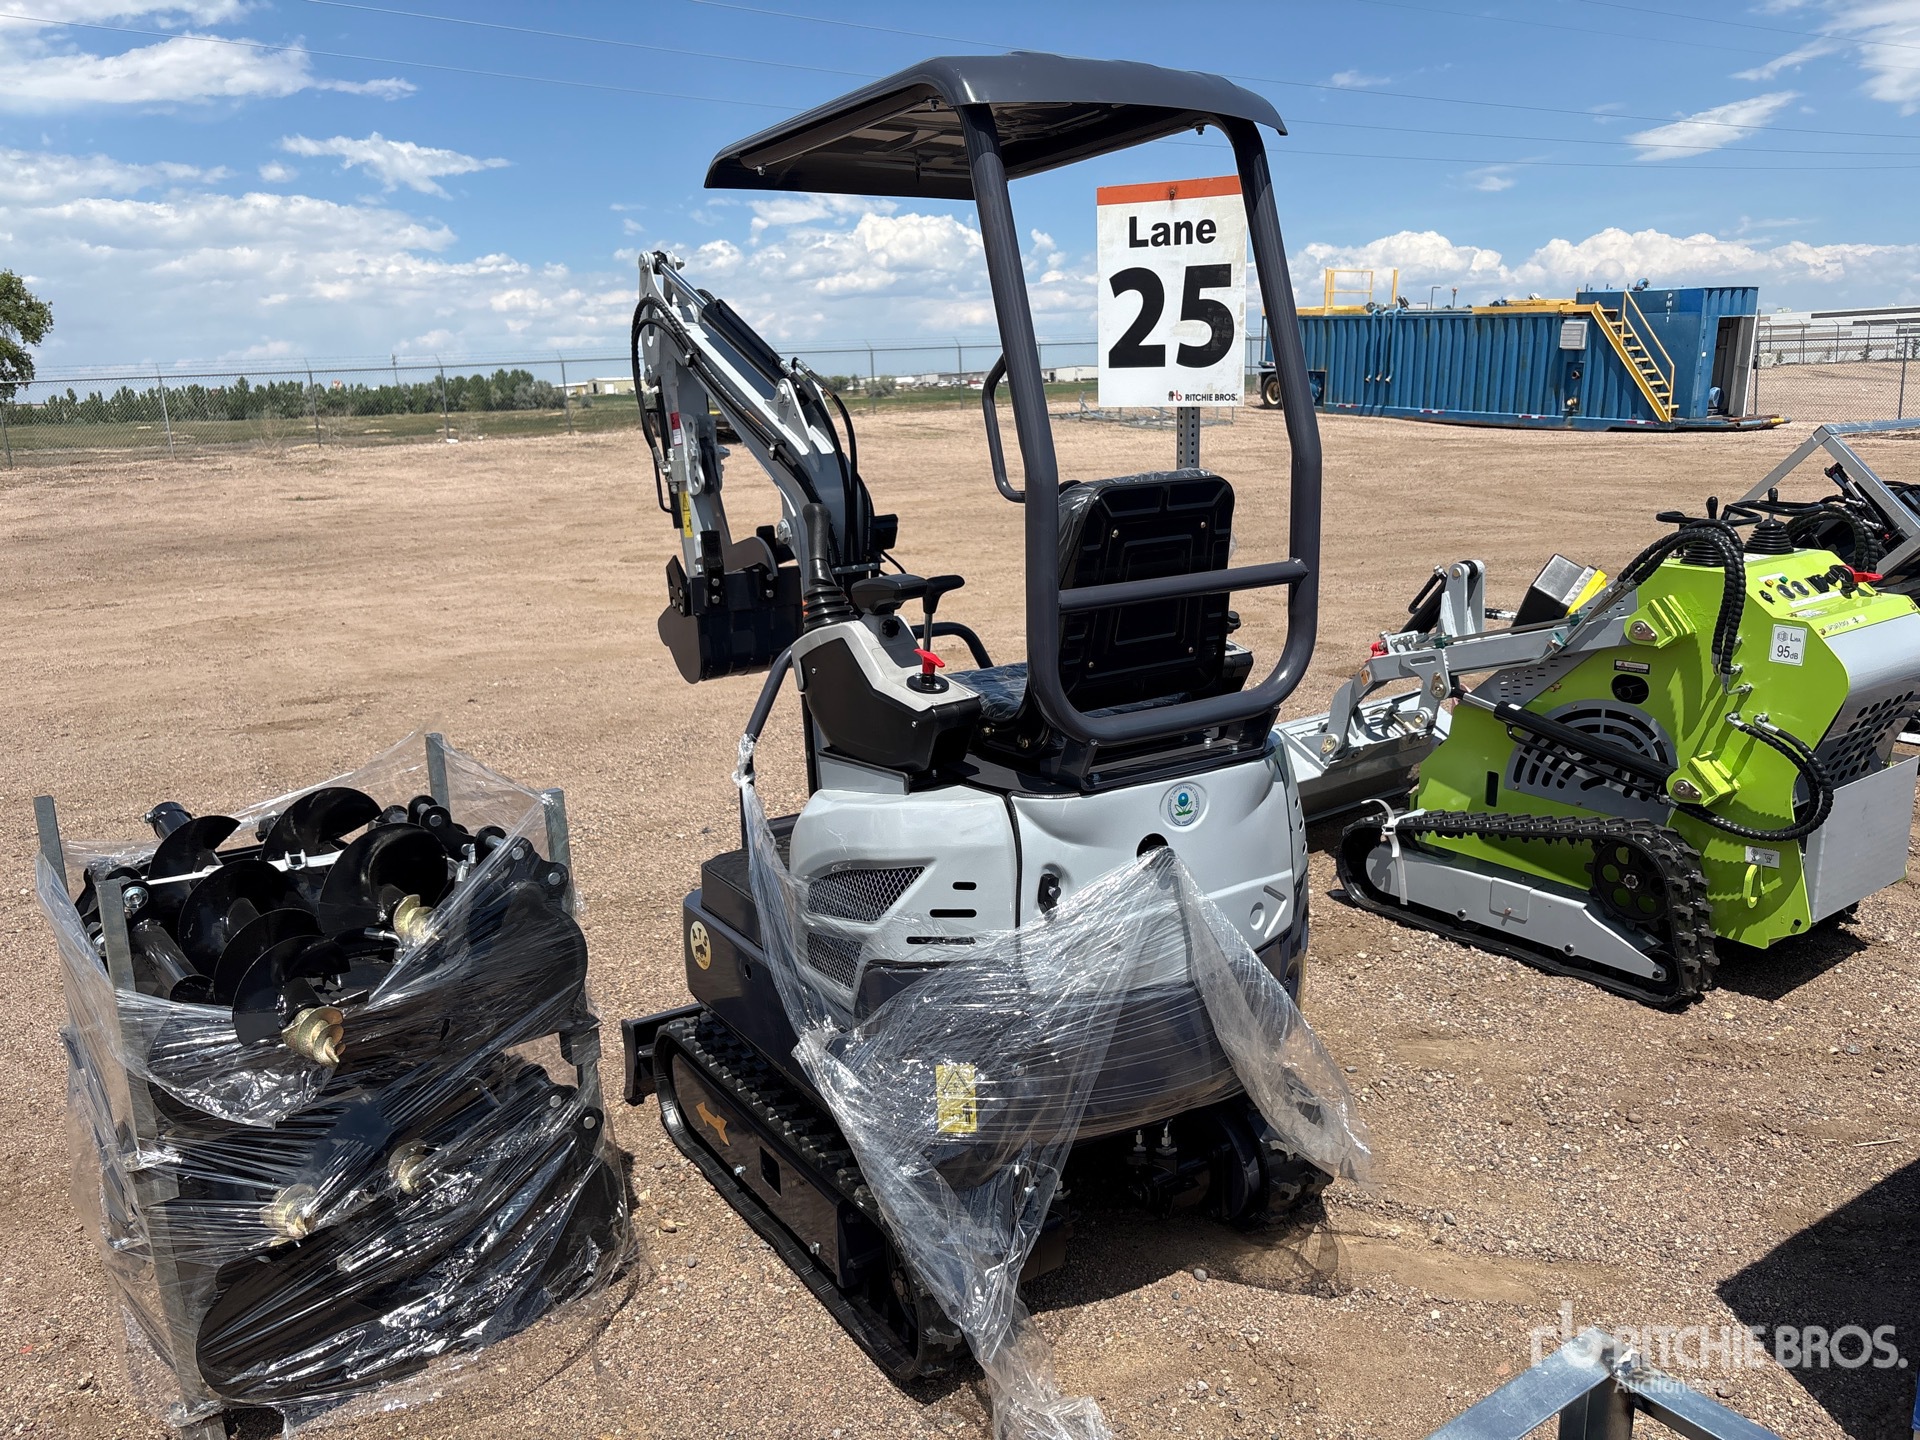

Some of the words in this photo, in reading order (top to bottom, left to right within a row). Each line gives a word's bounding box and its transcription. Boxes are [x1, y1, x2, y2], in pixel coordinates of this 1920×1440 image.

[1129, 216, 1217, 248] Lane
[1108, 263, 1235, 369] 25
[1185, 393, 1213, 402] RITCHIE
[1214, 393, 1238, 402] BROS.
[692, 927, 708, 947] ATS
